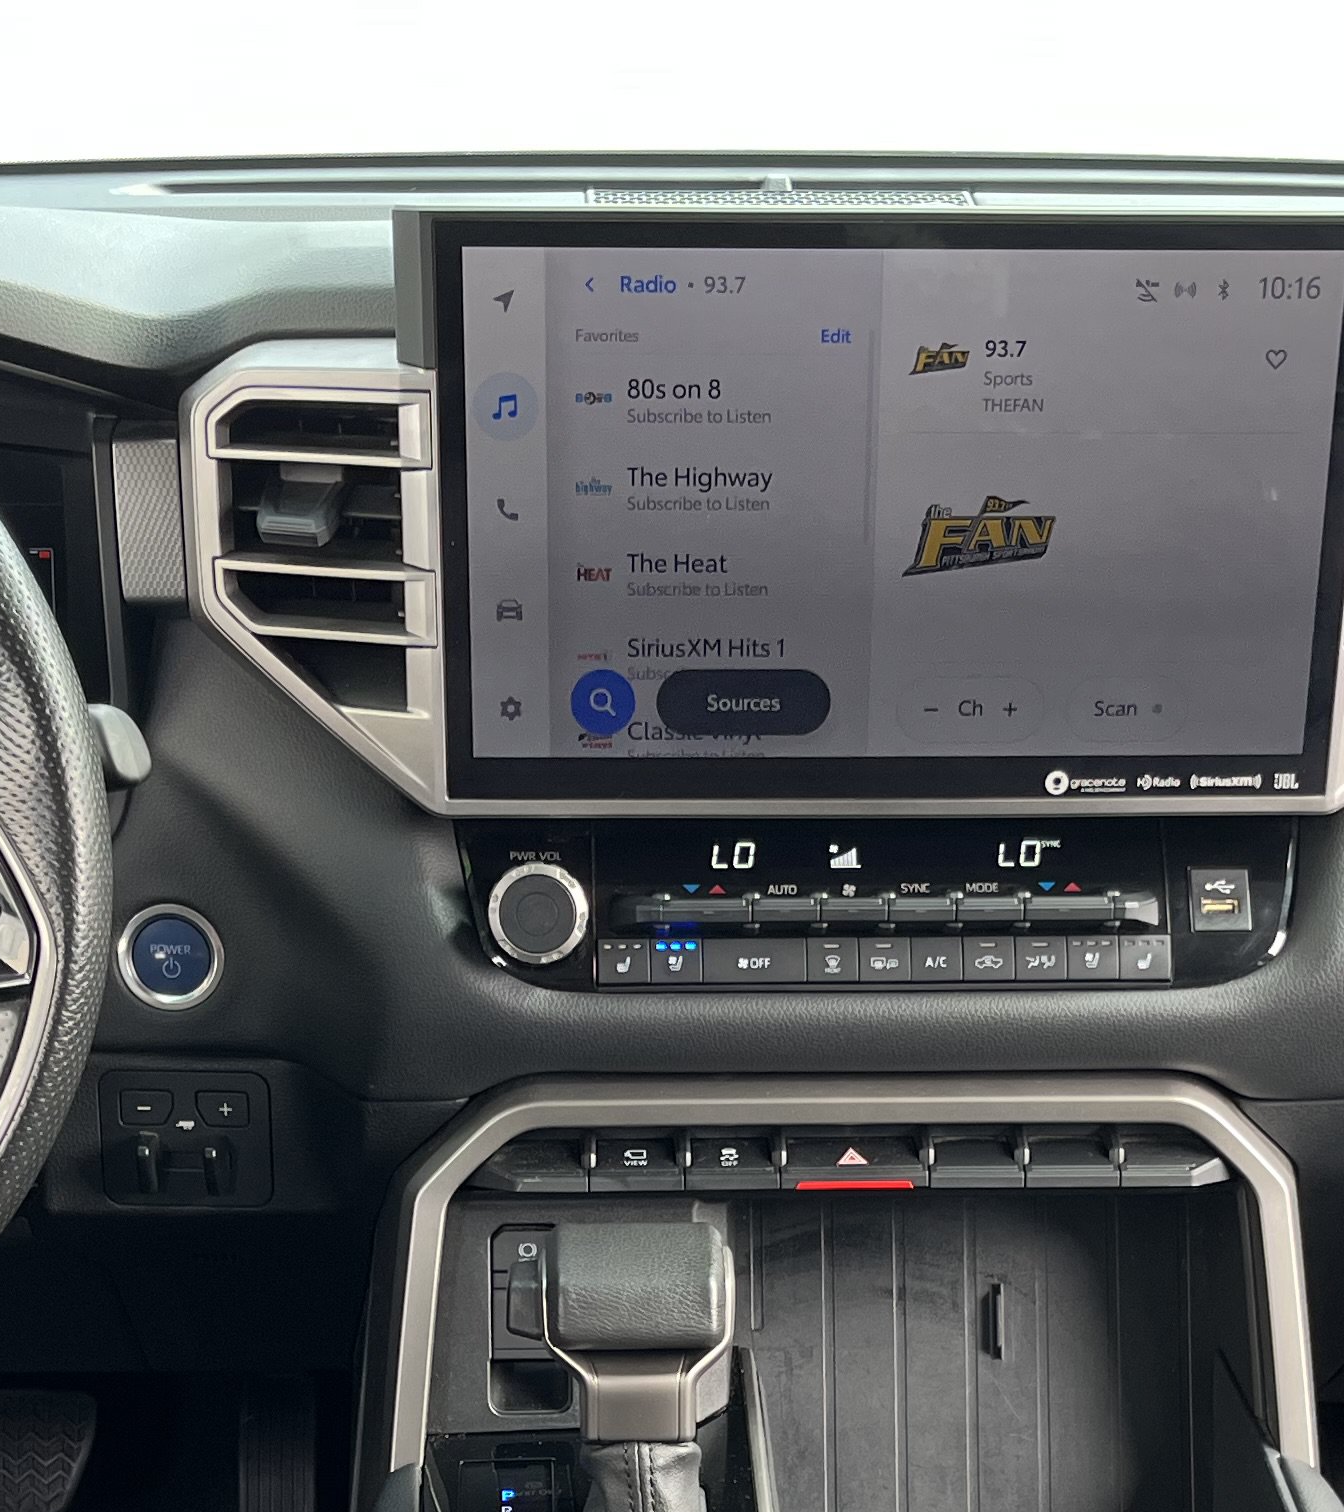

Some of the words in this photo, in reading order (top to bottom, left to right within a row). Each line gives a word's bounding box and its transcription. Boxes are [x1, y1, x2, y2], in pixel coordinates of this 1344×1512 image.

[619, 275, 677, 295] Radio
[703, 276, 747, 295] 93.7
[1258, 275, 1322, 300] 10:16
[575, 327, 640, 344] Favorites
[820, 328, 853, 345] Edit
[984, 339, 1027, 359] 93.7
[983, 371, 1033, 389] Sports
[627, 378, 667, 400] 80s
[672, 382, 702, 400] on
[707, 378, 722, 400] 8
[982, 397, 1044, 413] THEFAN
[626, 408, 704, 425] Subscribe
[706, 409, 723, 425] to
[725, 408, 773, 425] Listen
[626, 466, 668, 488] The
[674, 466, 773, 494] Highway
[626, 496, 703, 513] Subscribe
[705, 497, 723, 513] to
[725, 496, 771, 512] Listen
[915, 518, 1054, 569] FAN
[626, 553, 667, 574] The
[673, 553, 728, 574] Heat
[575, 567, 613, 582] HEAT
[626, 582, 703, 598] Subscribe
[705, 583, 723, 598] to
[724, 582, 769, 597] Listen
[627, 638, 722, 659] SiriusXM
[726, 638, 771, 659] Hits
[775, 638, 786, 659] 1
[706, 694, 781, 713] Sources
[958, 699, 984, 718] Ch
[1093, 700, 1137, 718] Scan
[1070, 777, 1127, 790] gracenote
[1152, 777, 1182, 788] Radio
[1277, 773, 1299, 790] JBL
[509, 851, 536, 861] PWR
[539, 851, 563, 861] VOL
[711, 841, 756, 870] LO
[997, 840, 1042, 868] LO
[767, 884, 798, 896] AUTO
[900, 882, 931, 894] SYNC
[965, 882, 1000, 894] MODE
[149, 943, 192, 956] POWER
[749, 957, 772, 969] OFF
[924, 956, 948, 969] A/C
[501, 1489, 515, 1502] P
